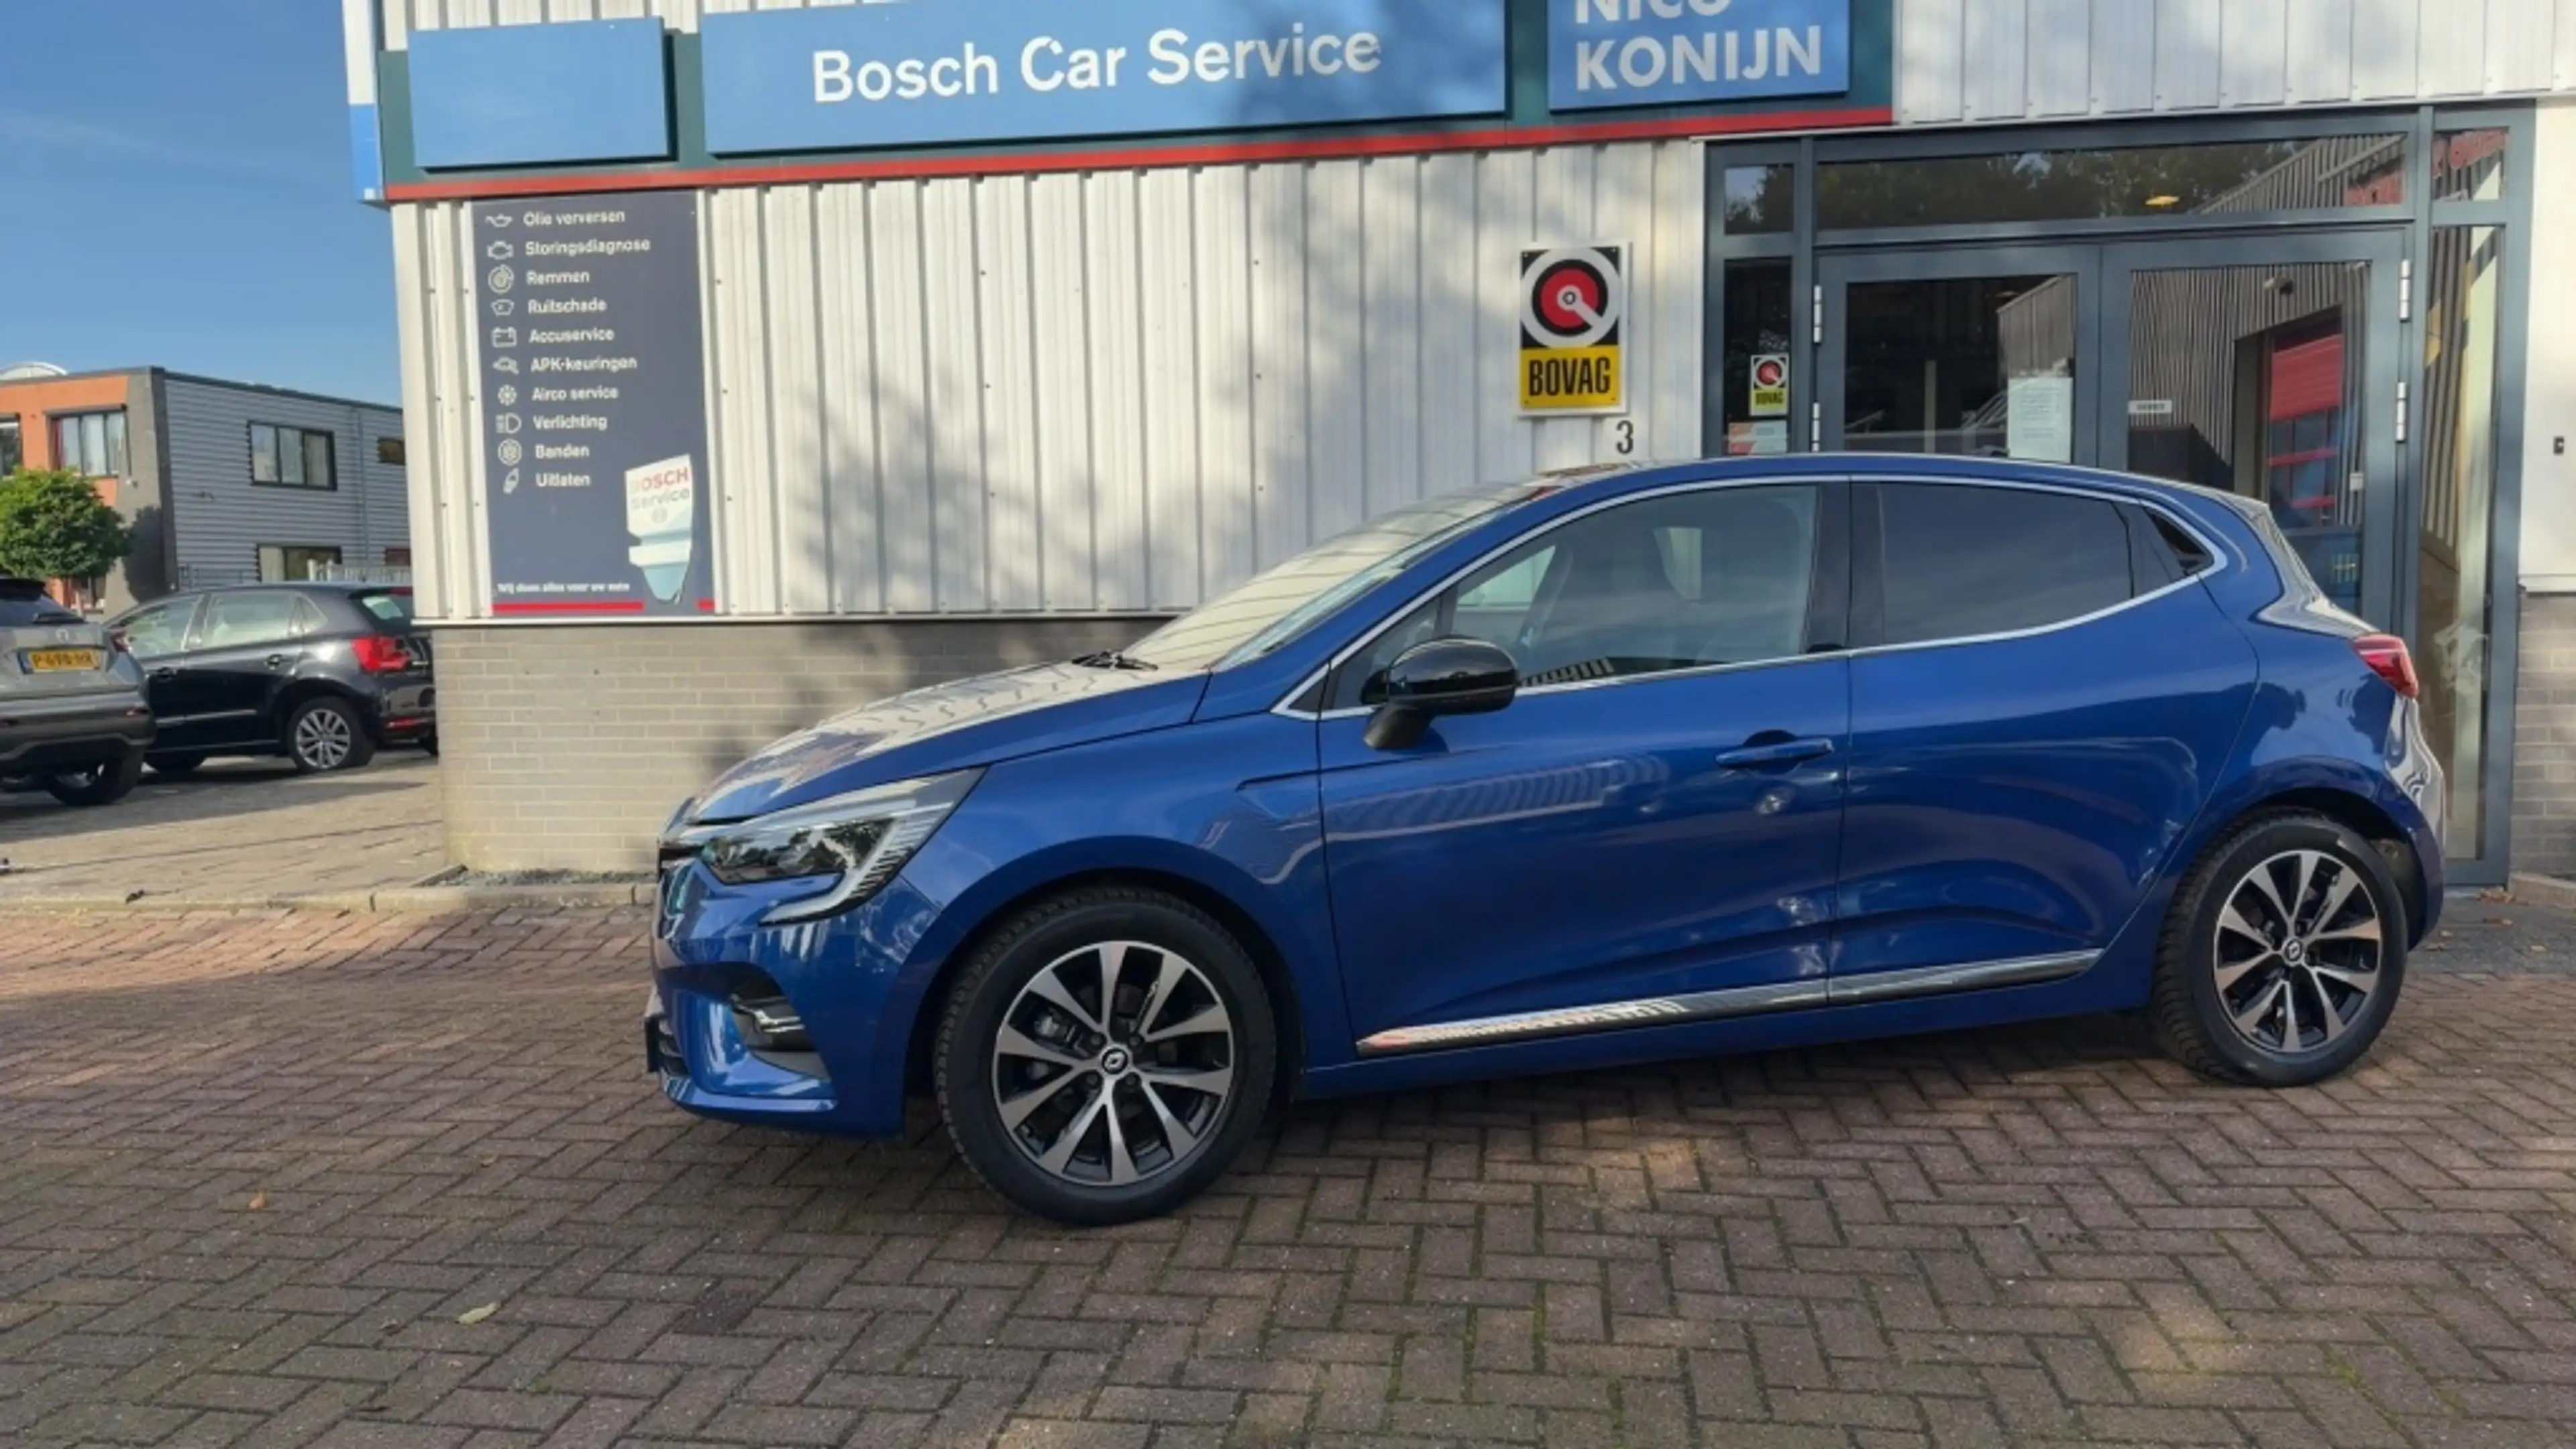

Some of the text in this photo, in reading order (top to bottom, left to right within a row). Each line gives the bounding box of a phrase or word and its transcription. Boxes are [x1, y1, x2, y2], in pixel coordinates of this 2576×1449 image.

[812, 22, 1381, 103] Bosch Car Service
[1576, 25, 1821, 91] KONIJN
[523, 210, 626, 226] Olie verversen
[525, 238, 651, 256] Storingsdiagnose
[526, 270, 590, 285] Remmen
[527, 297, 606, 314] Ruitschade
[529, 326, 614, 343] Accuservice
[530, 356, 637, 372] APK-keuringen
[1529, 356, 1610, 396] BOVAG
[531, 385, 619, 401] Airco service
[533, 414, 607, 431] Verlichting
[1616, 420, 1634, 455] 3
[535, 443, 590, 459] Banden
[536, 472, 590, 487] Uitlaten
